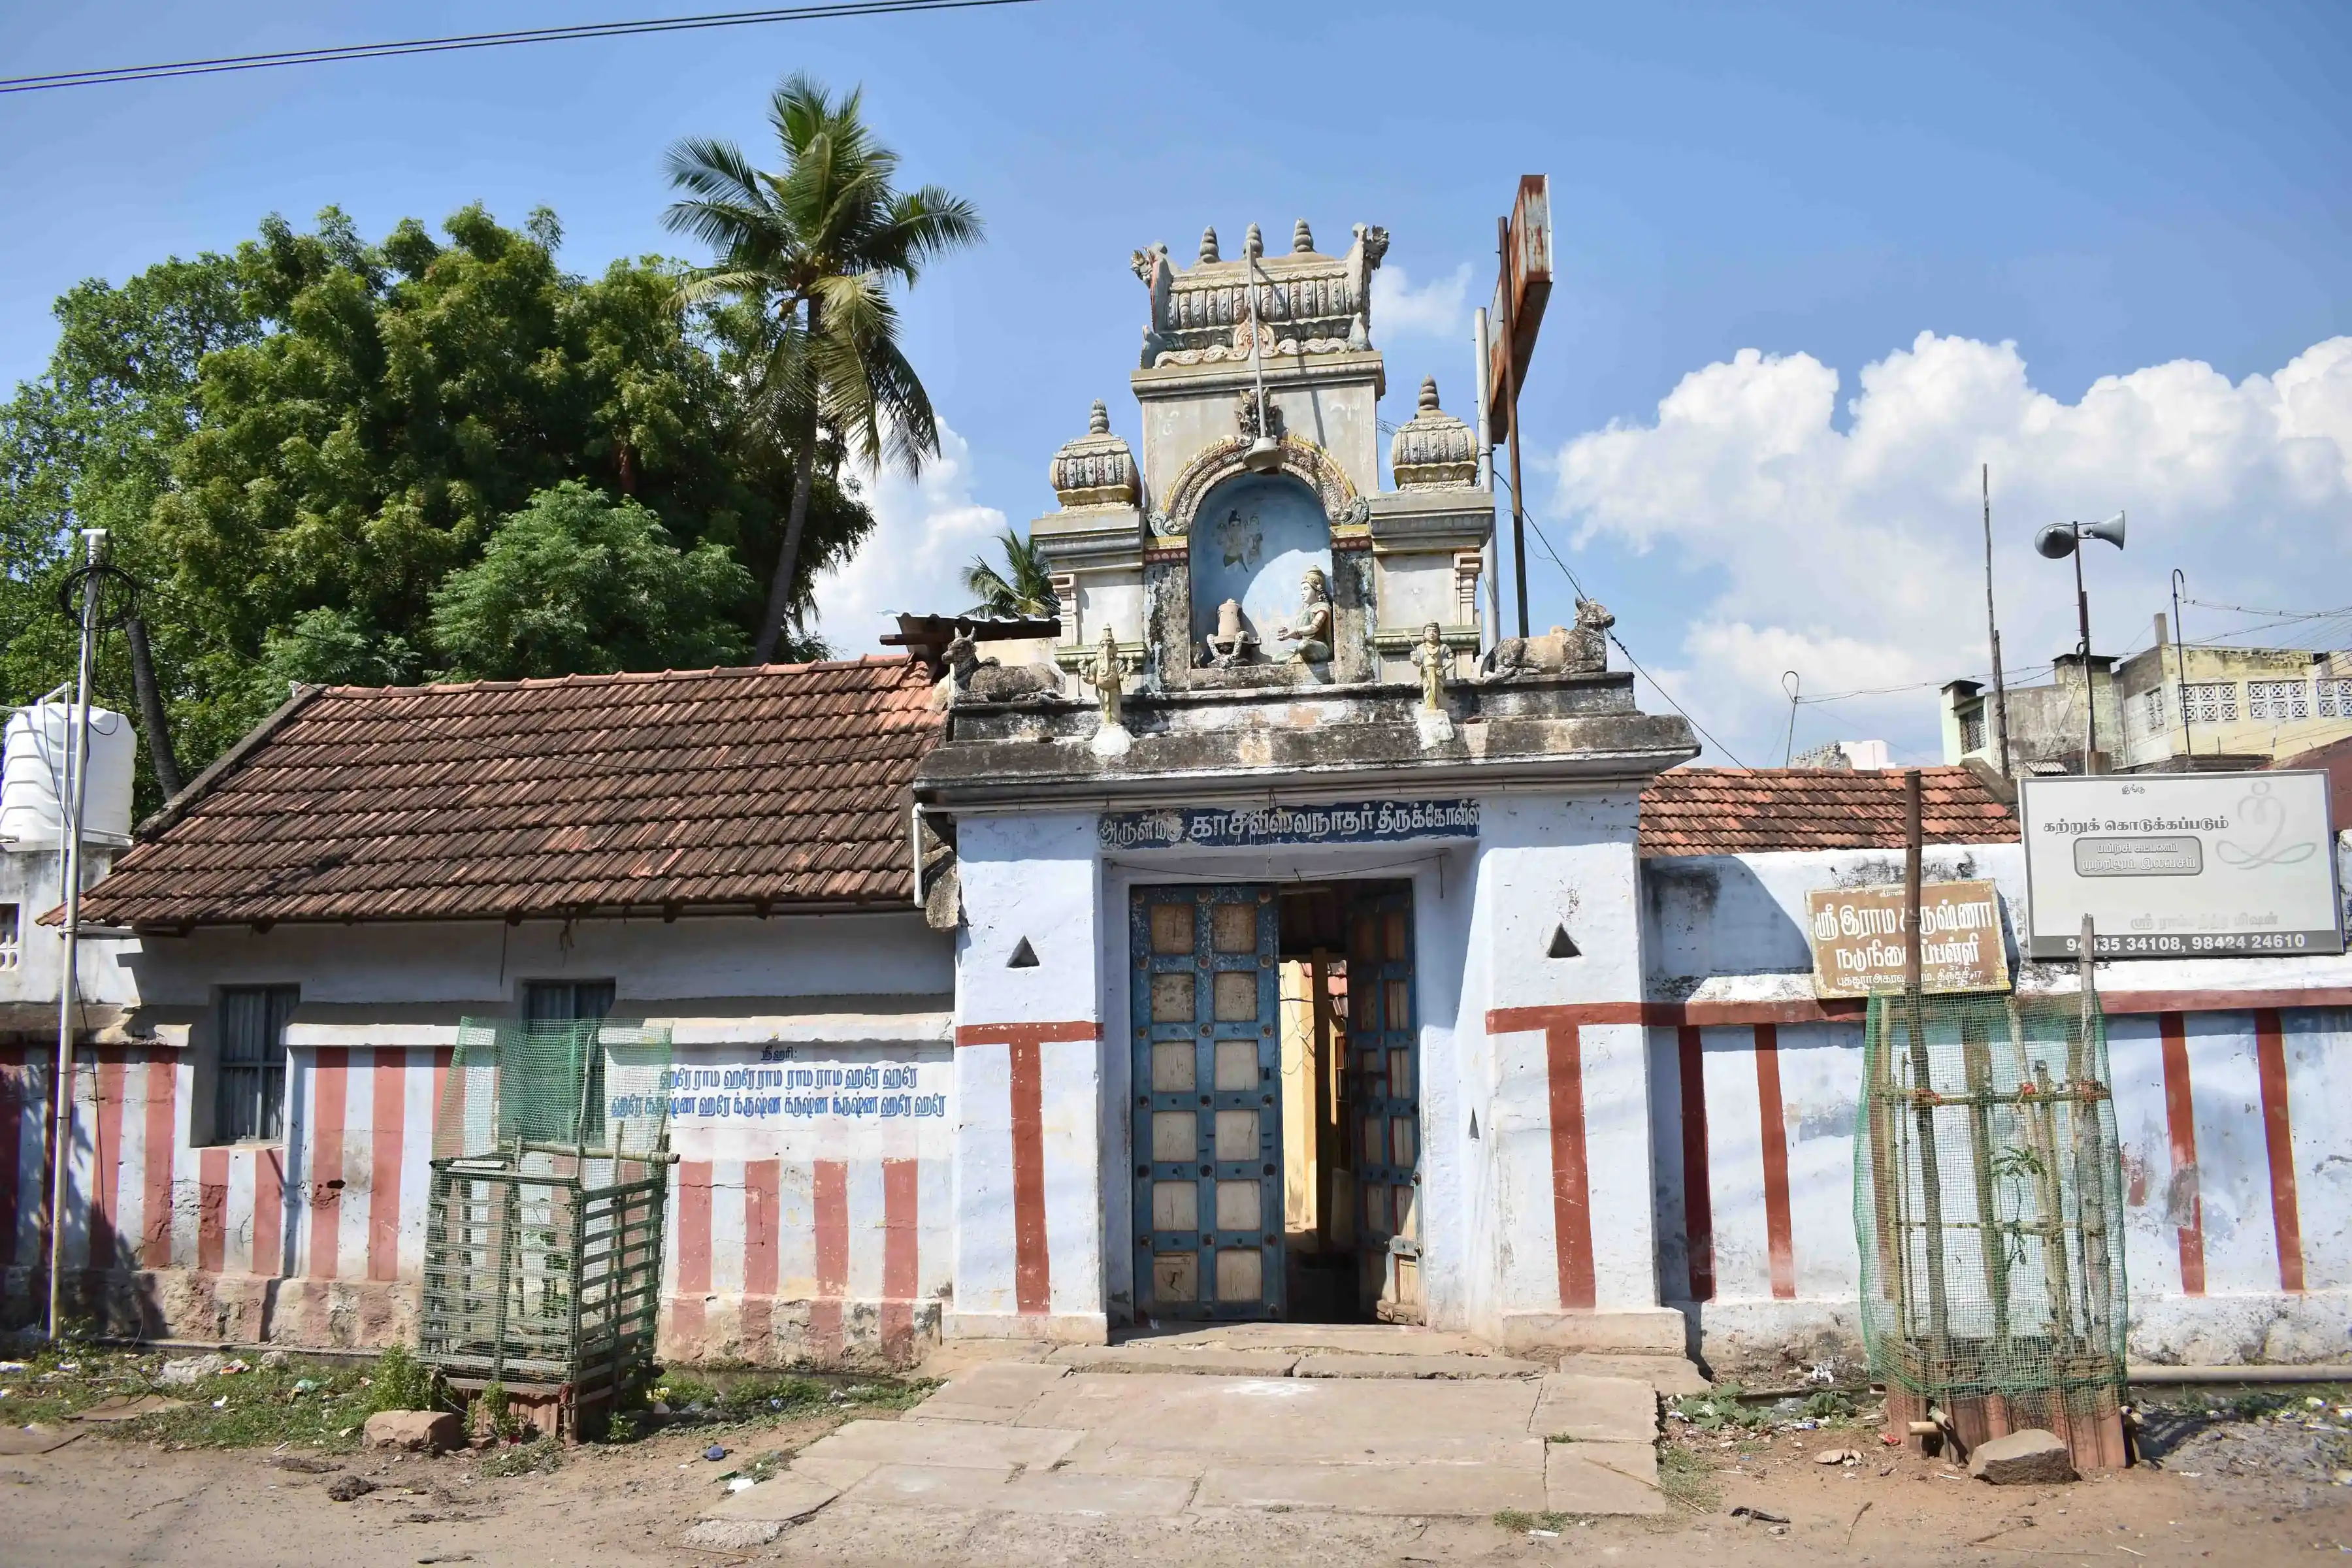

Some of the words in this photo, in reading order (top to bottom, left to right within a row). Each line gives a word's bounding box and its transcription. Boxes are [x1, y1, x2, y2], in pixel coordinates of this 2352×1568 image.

[2121, 783, 2146, 795] இங்கு
[2043, 817, 2100, 836] கற்றுக்
[2104, 815, 2229, 832] கொடுக்கப்படும்
[2126, 936, 2187, 953] 34108,
[2191, 936, 2246, 951] 98424
[2251, 933, 2305, 949] 24610
[693, 1070, 721, 1090] ராம
[723, 1068, 756, 1090] ஹரே
[755, 1070, 783, 1090] ராம
[785, 1070, 813, 1090] ராம
[815, 1069, 843, 1089] ராம
[845, 1066, 879, 1089] ஹரே
[883, 1066, 918, 1088] ஹரே
[698, 1094, 731, 1117] ஹரே
[879, 1093, 912, 1117] ஹரே
[915, 1092, 947, 1117] ஹரே
